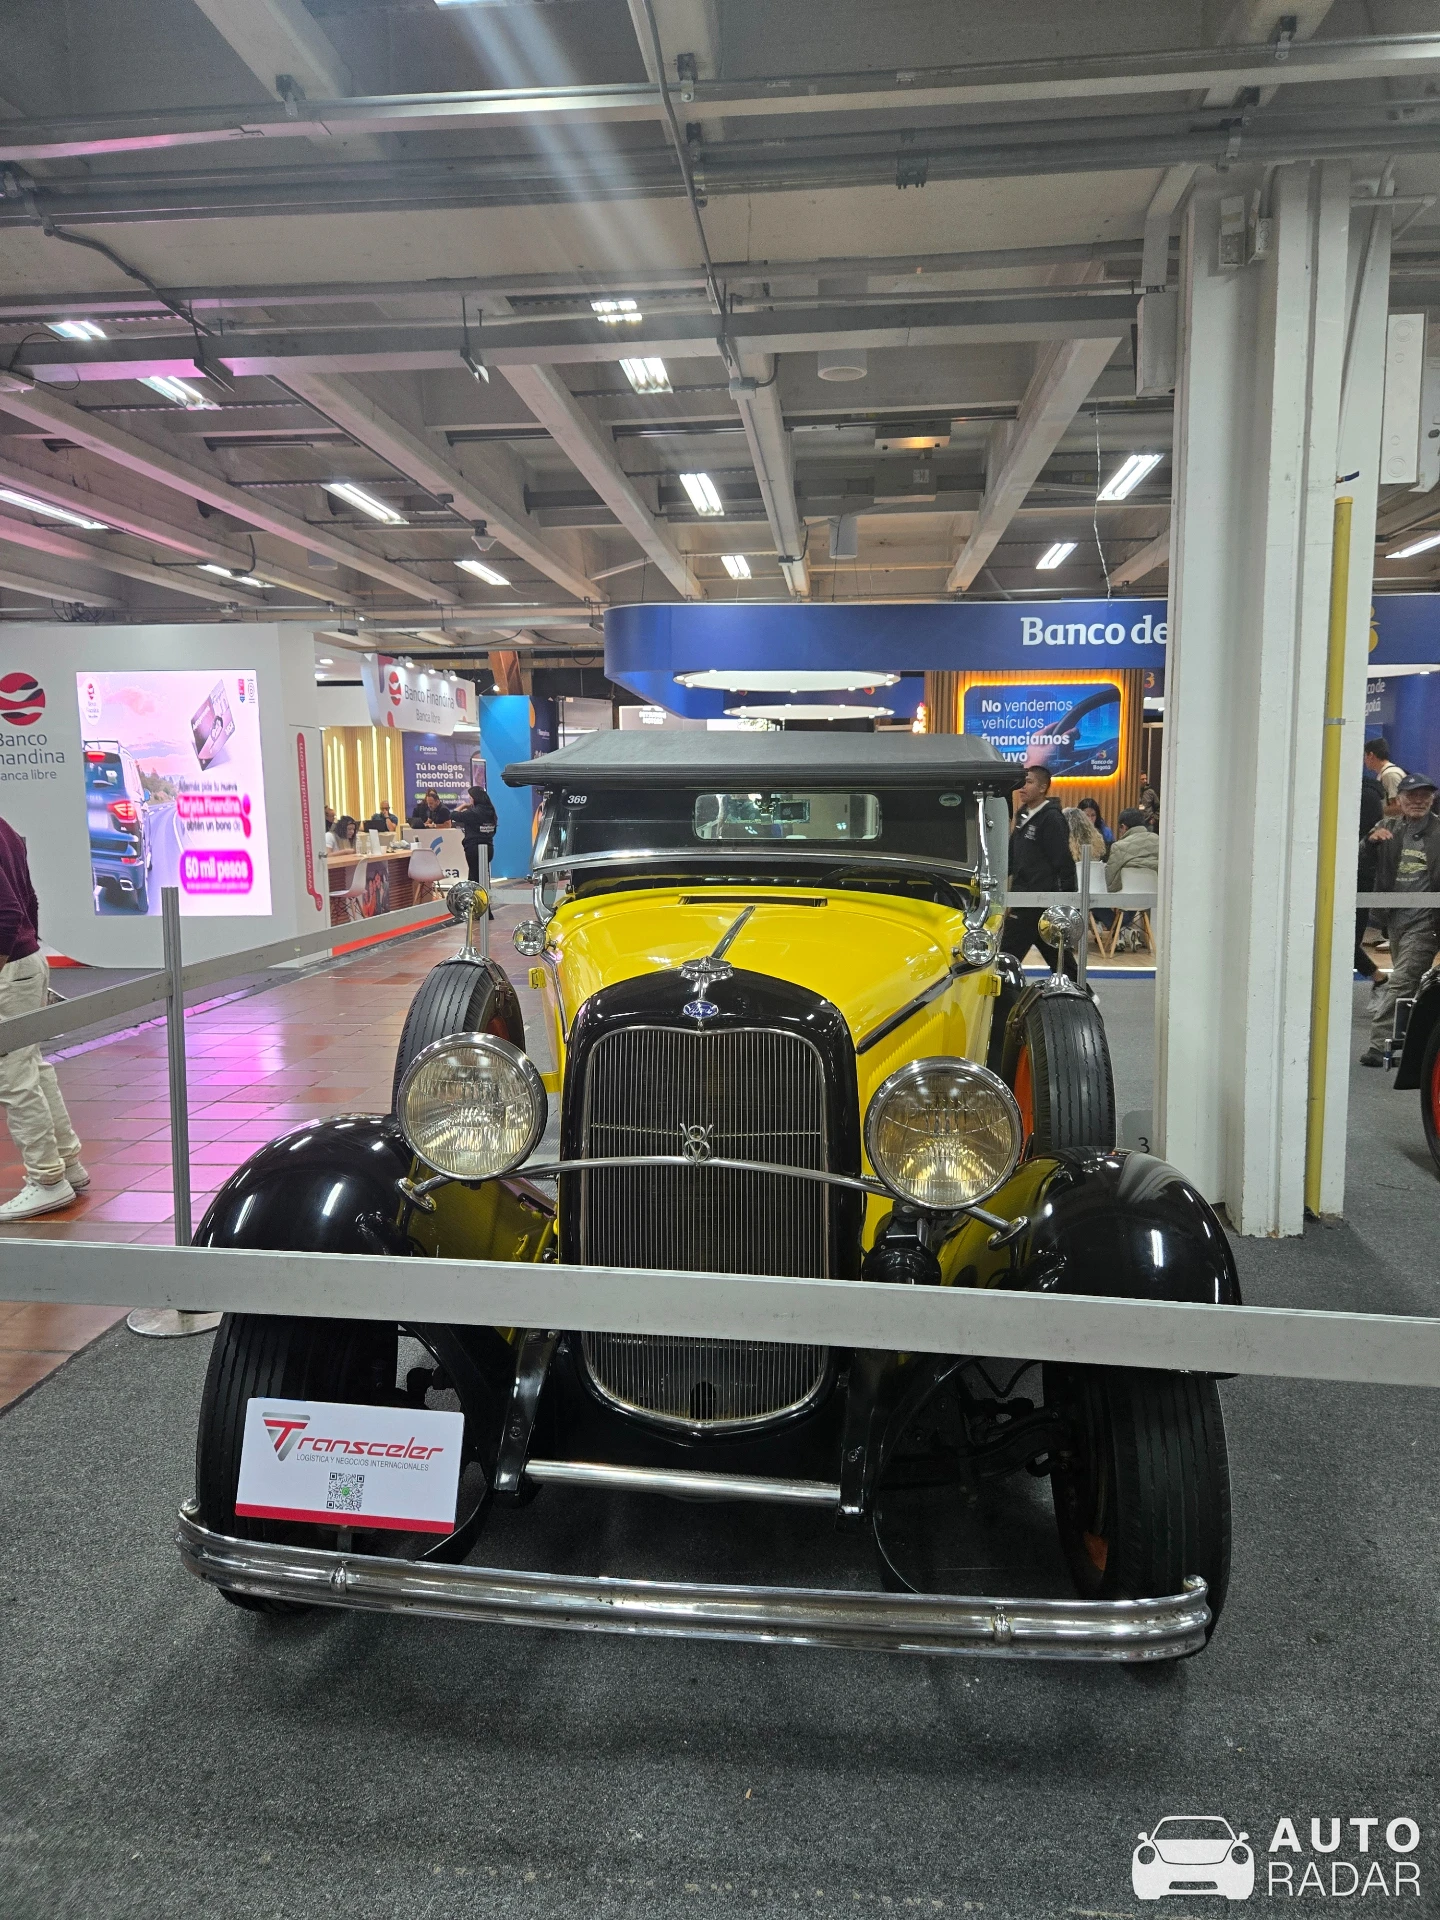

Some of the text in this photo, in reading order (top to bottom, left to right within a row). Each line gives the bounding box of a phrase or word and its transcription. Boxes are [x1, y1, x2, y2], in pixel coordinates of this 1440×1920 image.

[1020, 615, 1168, 646] Banco de
[404, 684, 425, 703] Banco
[426, 688, 455, 710] Finandina
[981, 699, 1073, 713] No vendemos
[415, 709, 431, 723] Banca
[30, 768, 58, 780] libre
[415, 762, 465, 773] Tú lo eliges,
[415, 772, 464, 780] nosotros lo
[567, 795, 588, 805] 369
[185, 856, 249, 883] 50 mil pesos
[263, 1418, 444, 1461] Transceler
[296, 1453, 430, 1472] LOGÍSTICA Y NEGOCIOS INTERNACIONALES
